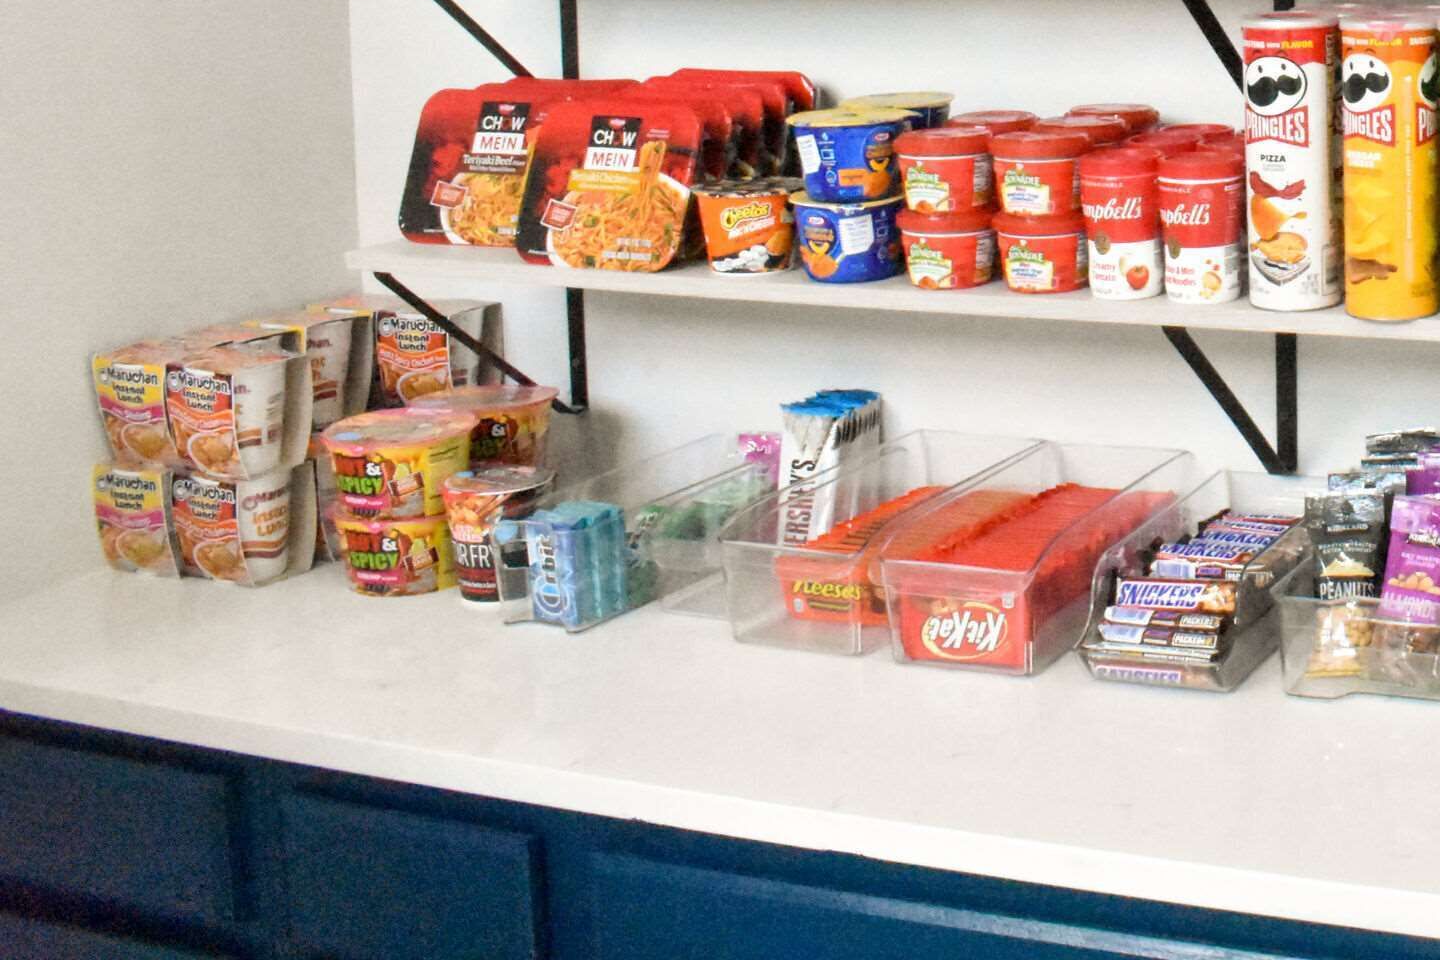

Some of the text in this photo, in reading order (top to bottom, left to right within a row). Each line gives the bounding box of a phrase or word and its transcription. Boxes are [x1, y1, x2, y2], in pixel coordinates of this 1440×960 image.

[1281, 40, 1314, 49] FLAVOR
[1248, 109, 1305, 143] PRINGLES
[480, 135, 517, 151] MEIN
[592, 151, 629, 167] MEIN
[1260, 154, 1286, 163] PIZZA
[721, 203, 770, 230] Cheetos
[1082, 196, 1143, 223] mpbell's
[391, 318, 443, 333] Maruchan
[395, 333, 429, 342] Instant
[399, 342, 427, 351] Lunch
[107, 367, 158, 384] Maruchan
[178, 373, 228, 393] Maruchan
[117, 393, 144, 404] Lunch
[183, 390, 216, 402] Instant
[187, 401, 213, 412] Lunch
[366, 463, 382, 476] &
[106, 474, 156, 491] Maruchan
[184, 480, 234, 501] Maruchan
[337, 475, 383, 495] SPICY
[785, 459, 816, 544] ERSHEY'S
[381, 538, 398, 552] &
[350, 552, 399, 570] SPICY
[1118, 583, 1202, 607] SNICKERS
[1320, 580, 1375, 600] PEANUTS
[928, 610, 1006, 652] KitKat
